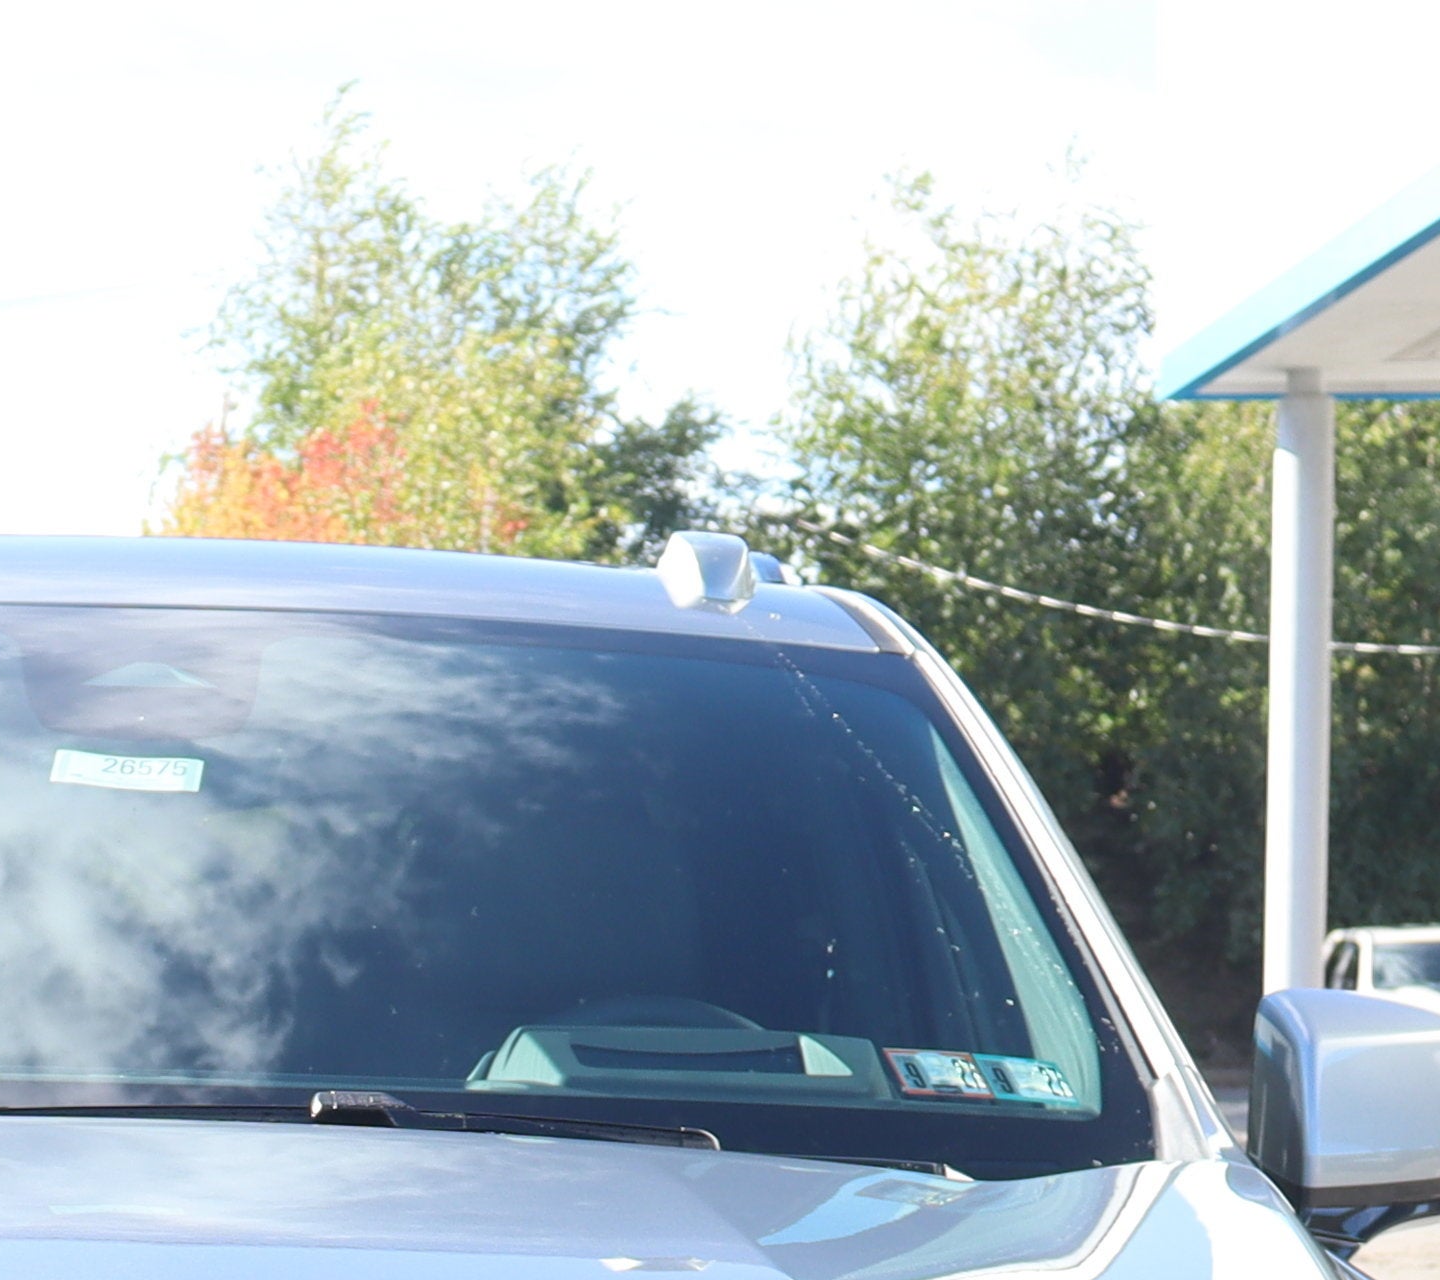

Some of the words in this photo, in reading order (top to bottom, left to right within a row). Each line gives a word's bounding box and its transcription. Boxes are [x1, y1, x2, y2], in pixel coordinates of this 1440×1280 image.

[101, 758, 189, 776] 26575
[905, 1062, 928, 1089] 9
[992, 1067, 1015, 1094] 9
